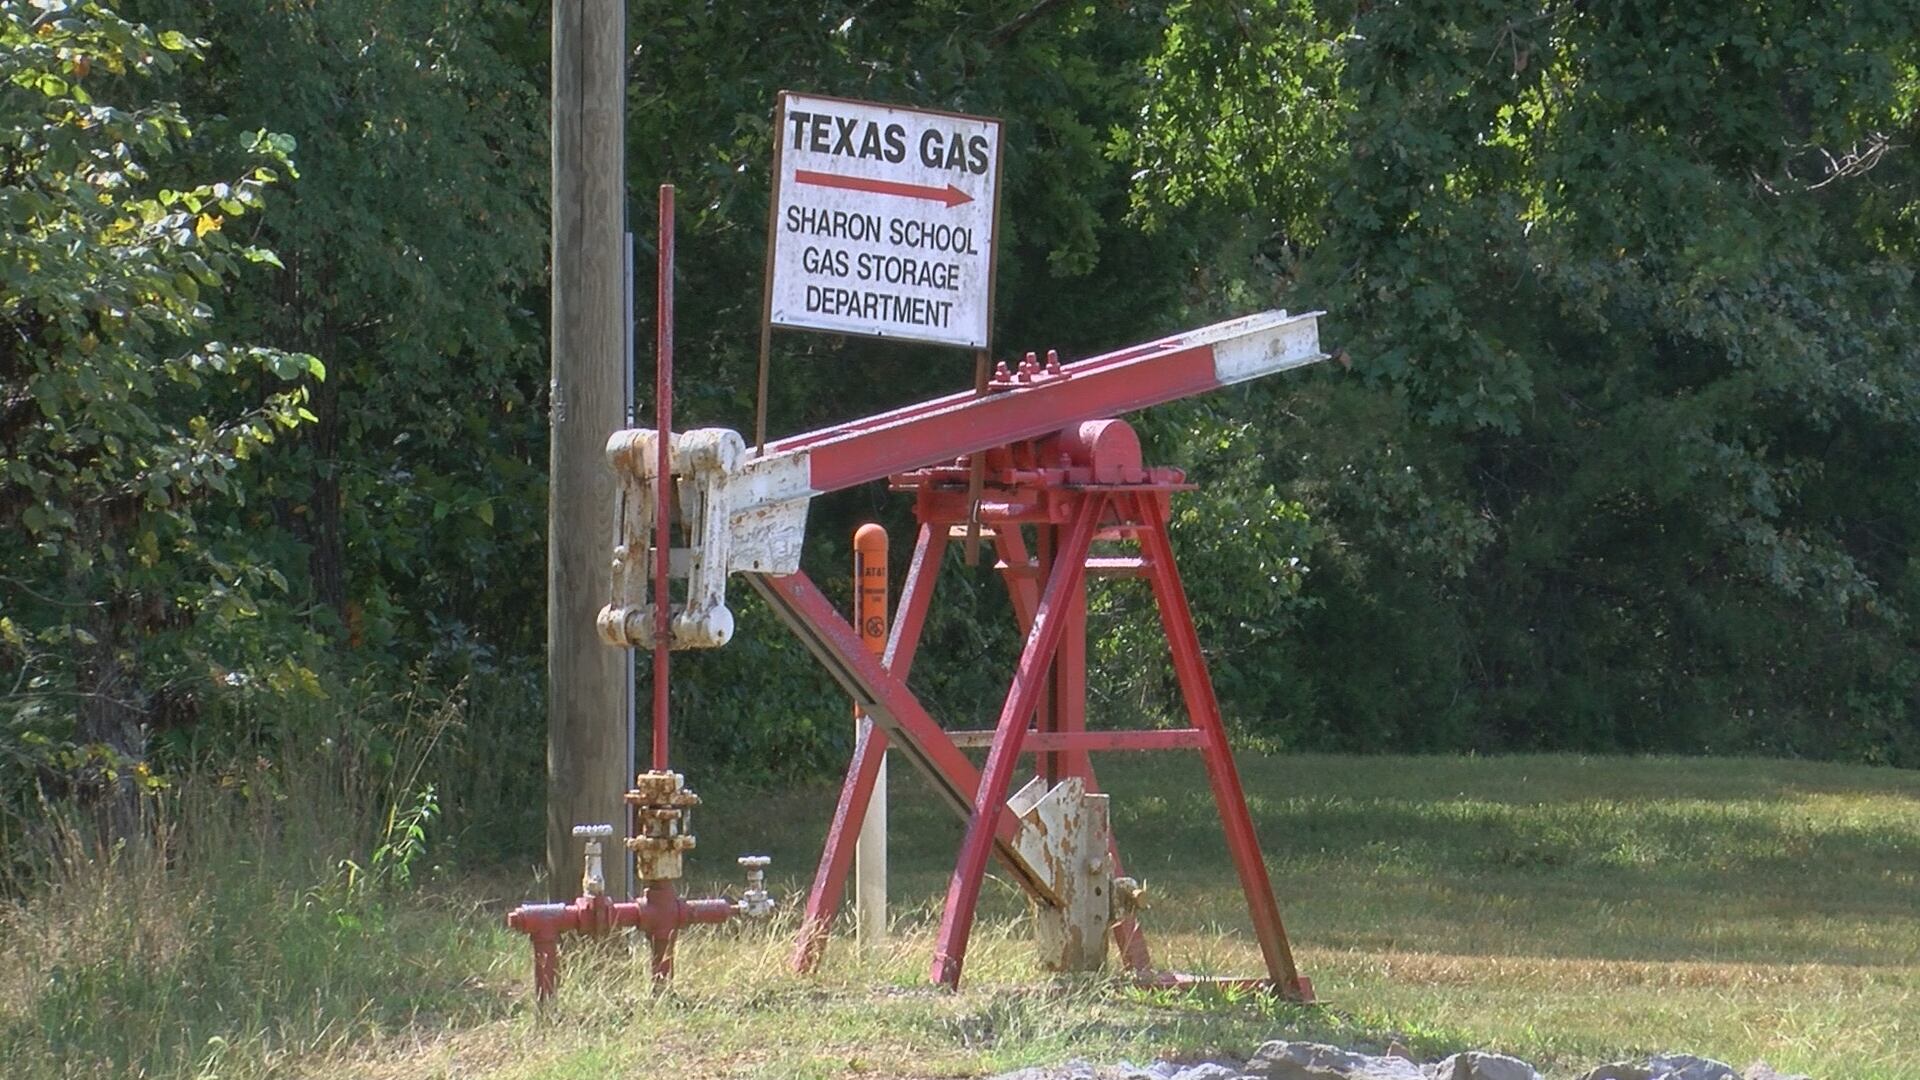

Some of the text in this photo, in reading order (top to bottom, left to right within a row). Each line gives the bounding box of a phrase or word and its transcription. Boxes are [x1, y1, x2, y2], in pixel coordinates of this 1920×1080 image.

[789, 111, 989, 175] TEXAS GAS
[786, 205, 978, 255] SHARON SCHOOL
[803, 246, 959, 291] GAS STORAGE
[806, 285, 953, 328] DEPARTMENT
